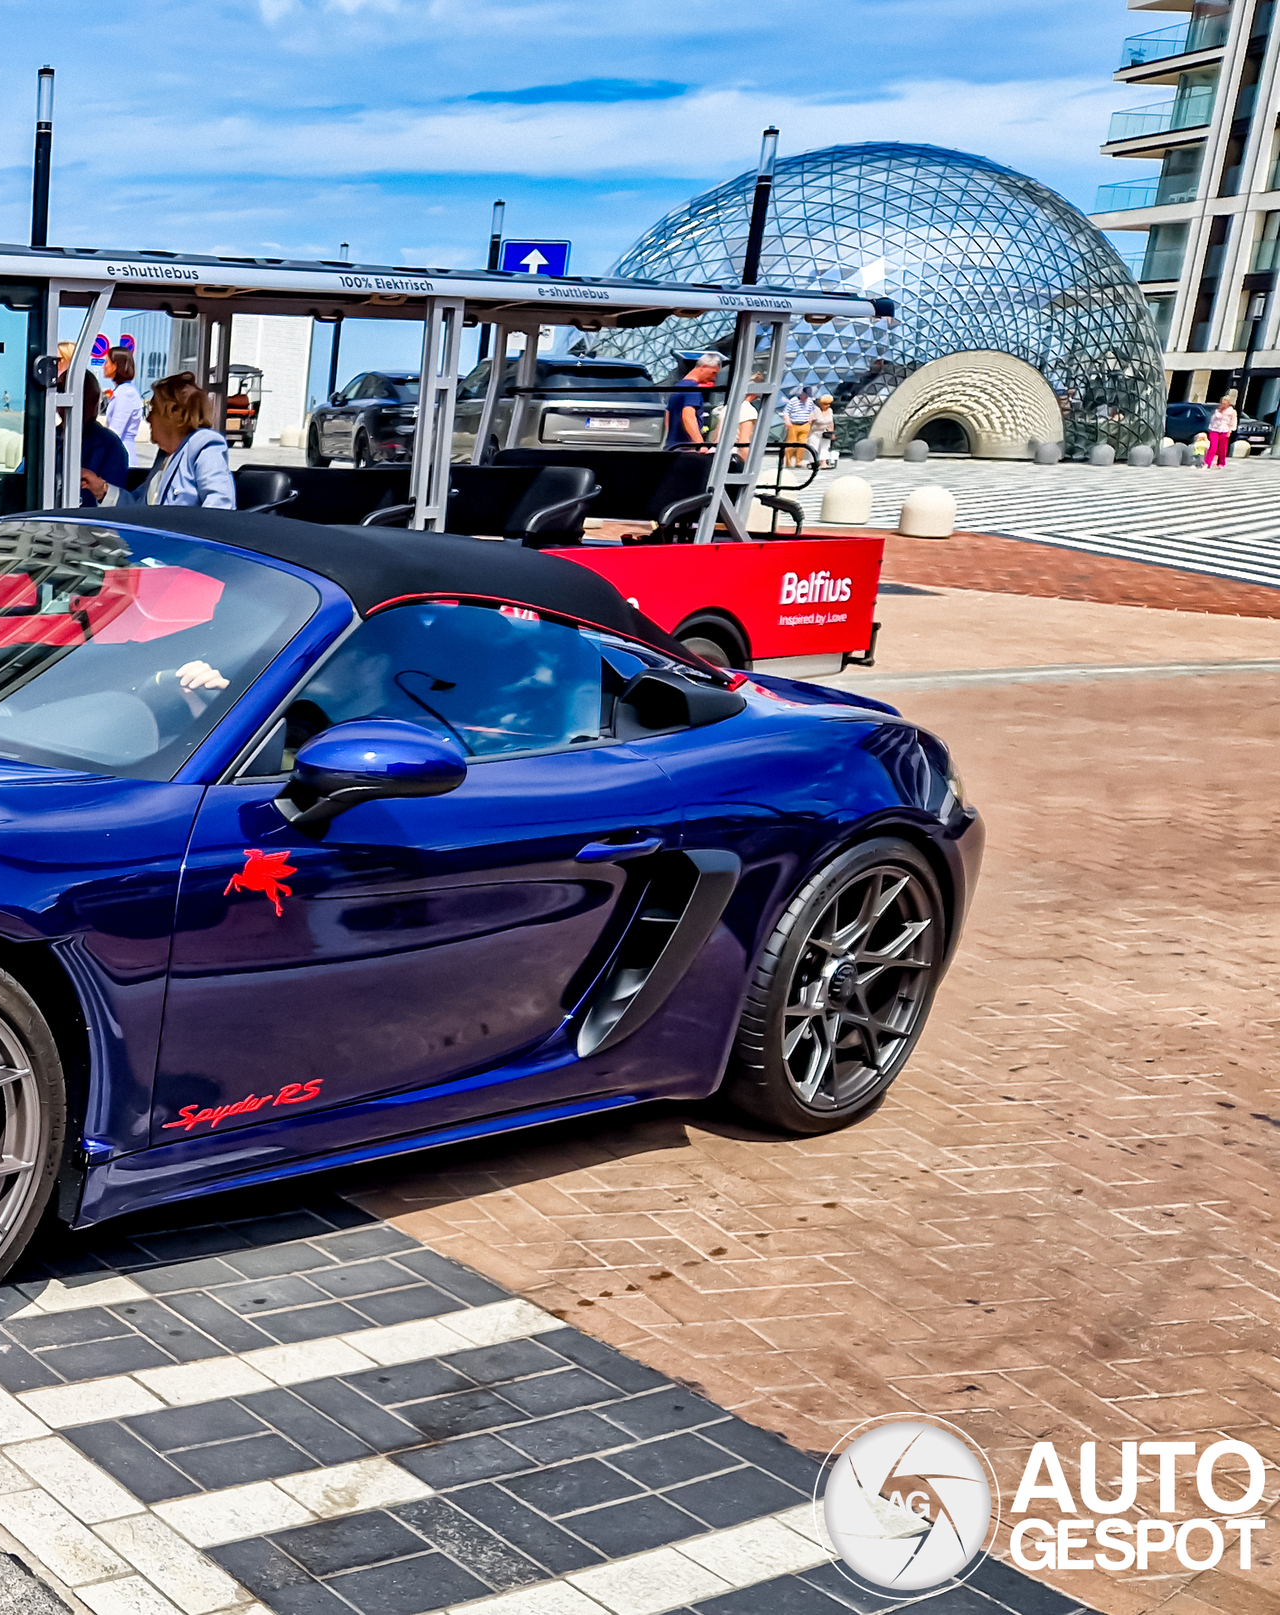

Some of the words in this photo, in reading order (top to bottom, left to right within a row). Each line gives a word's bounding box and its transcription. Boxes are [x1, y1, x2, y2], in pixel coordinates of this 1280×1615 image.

[106, 264, 200, 281] e-shuttlebus
[338, 276, 373, 289] 100%
[374, 277, 435, 292] Elektrisch
[537, 285, 610, 300] e-shuttlebus
[716, 295, 744, 307] 100%
[745, 296, 794, 310] Elektrisch
[778, 569, 853, 605] Belfius
[778, 613, 815, 628] Inspired
[815, 612, 827, 627] by
[826, 611, 848, 624] Love
[161, 1093, 274, 1132] Spyder
[271, 1078, 325, 1107] RS
